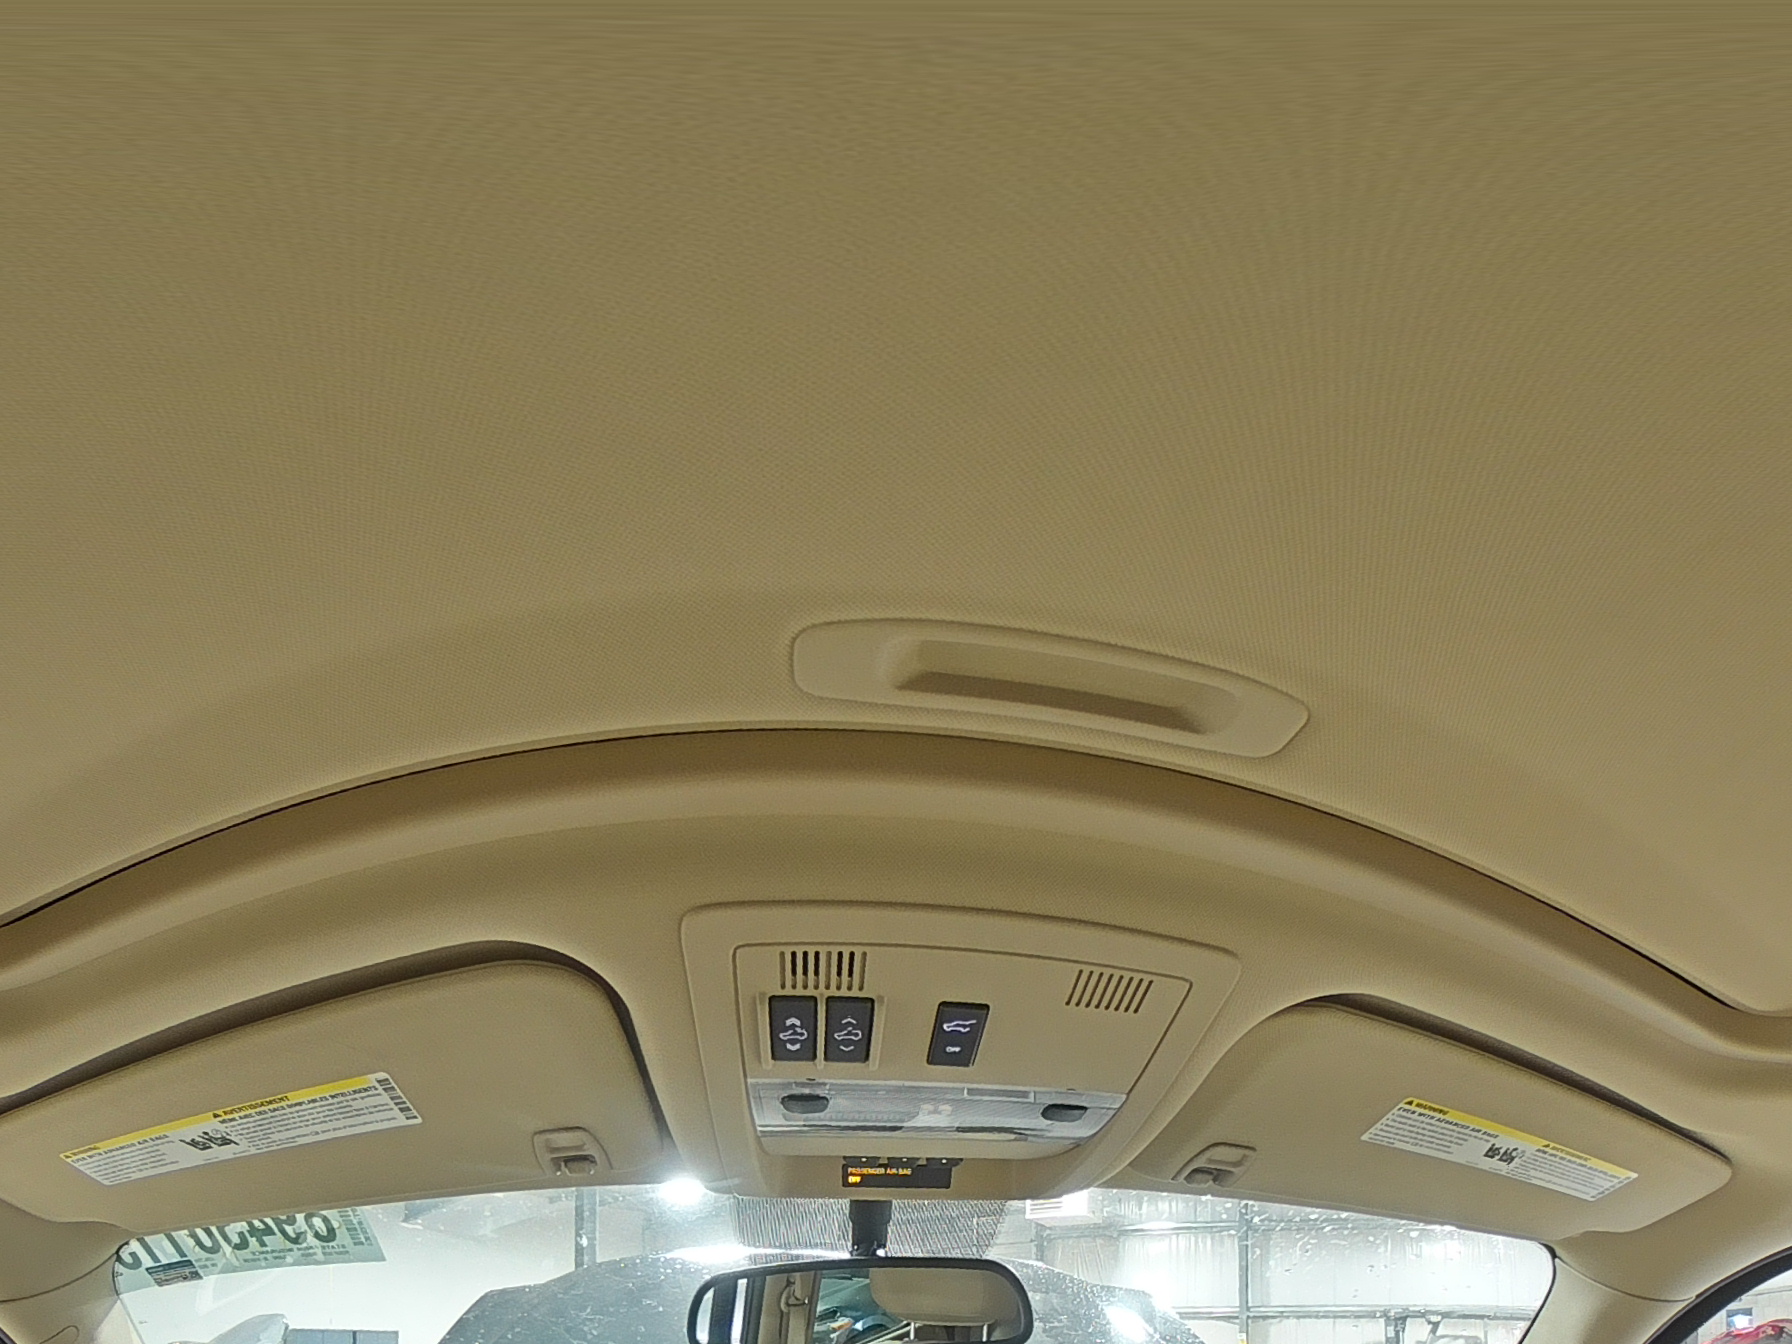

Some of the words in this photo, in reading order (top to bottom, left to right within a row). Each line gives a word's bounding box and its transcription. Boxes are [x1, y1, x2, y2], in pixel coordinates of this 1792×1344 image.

[222, 1095, 290, 1115] AVERTISSEMENT
[847, 1167, 885, 1175] PASSENGER
[848, 1176, 862, 1184] OFF
